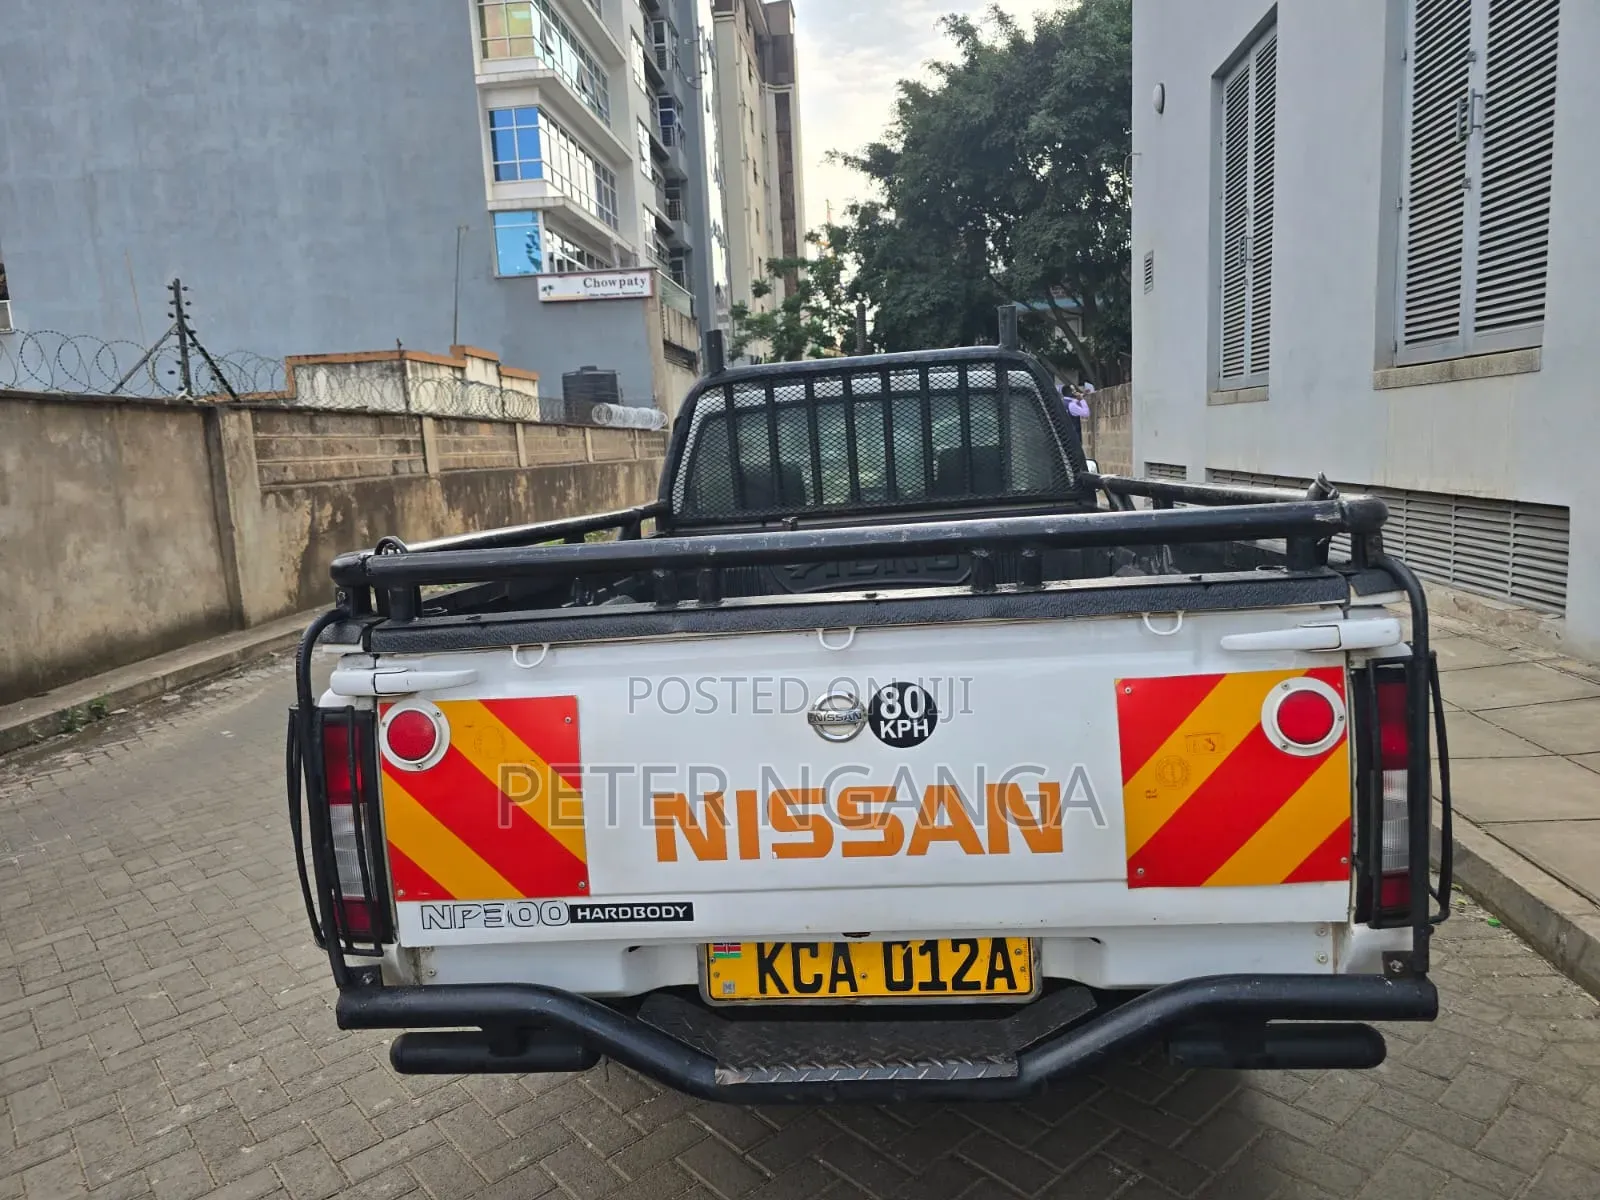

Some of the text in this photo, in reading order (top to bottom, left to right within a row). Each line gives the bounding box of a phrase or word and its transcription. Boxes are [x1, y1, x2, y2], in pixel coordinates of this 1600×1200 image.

[583, 274, 647, 289] Chowpaty
[879, 685, 926, 720] 80
[815, 713, 862, 723] NISSAN
[879, 718, 929, 739] KPH
[653, 781, 1064, 862] NISSAN
[420, 900, 688, 930] NP300 HARDBODY
[756, 937, 1018, 995] KCA 012A
